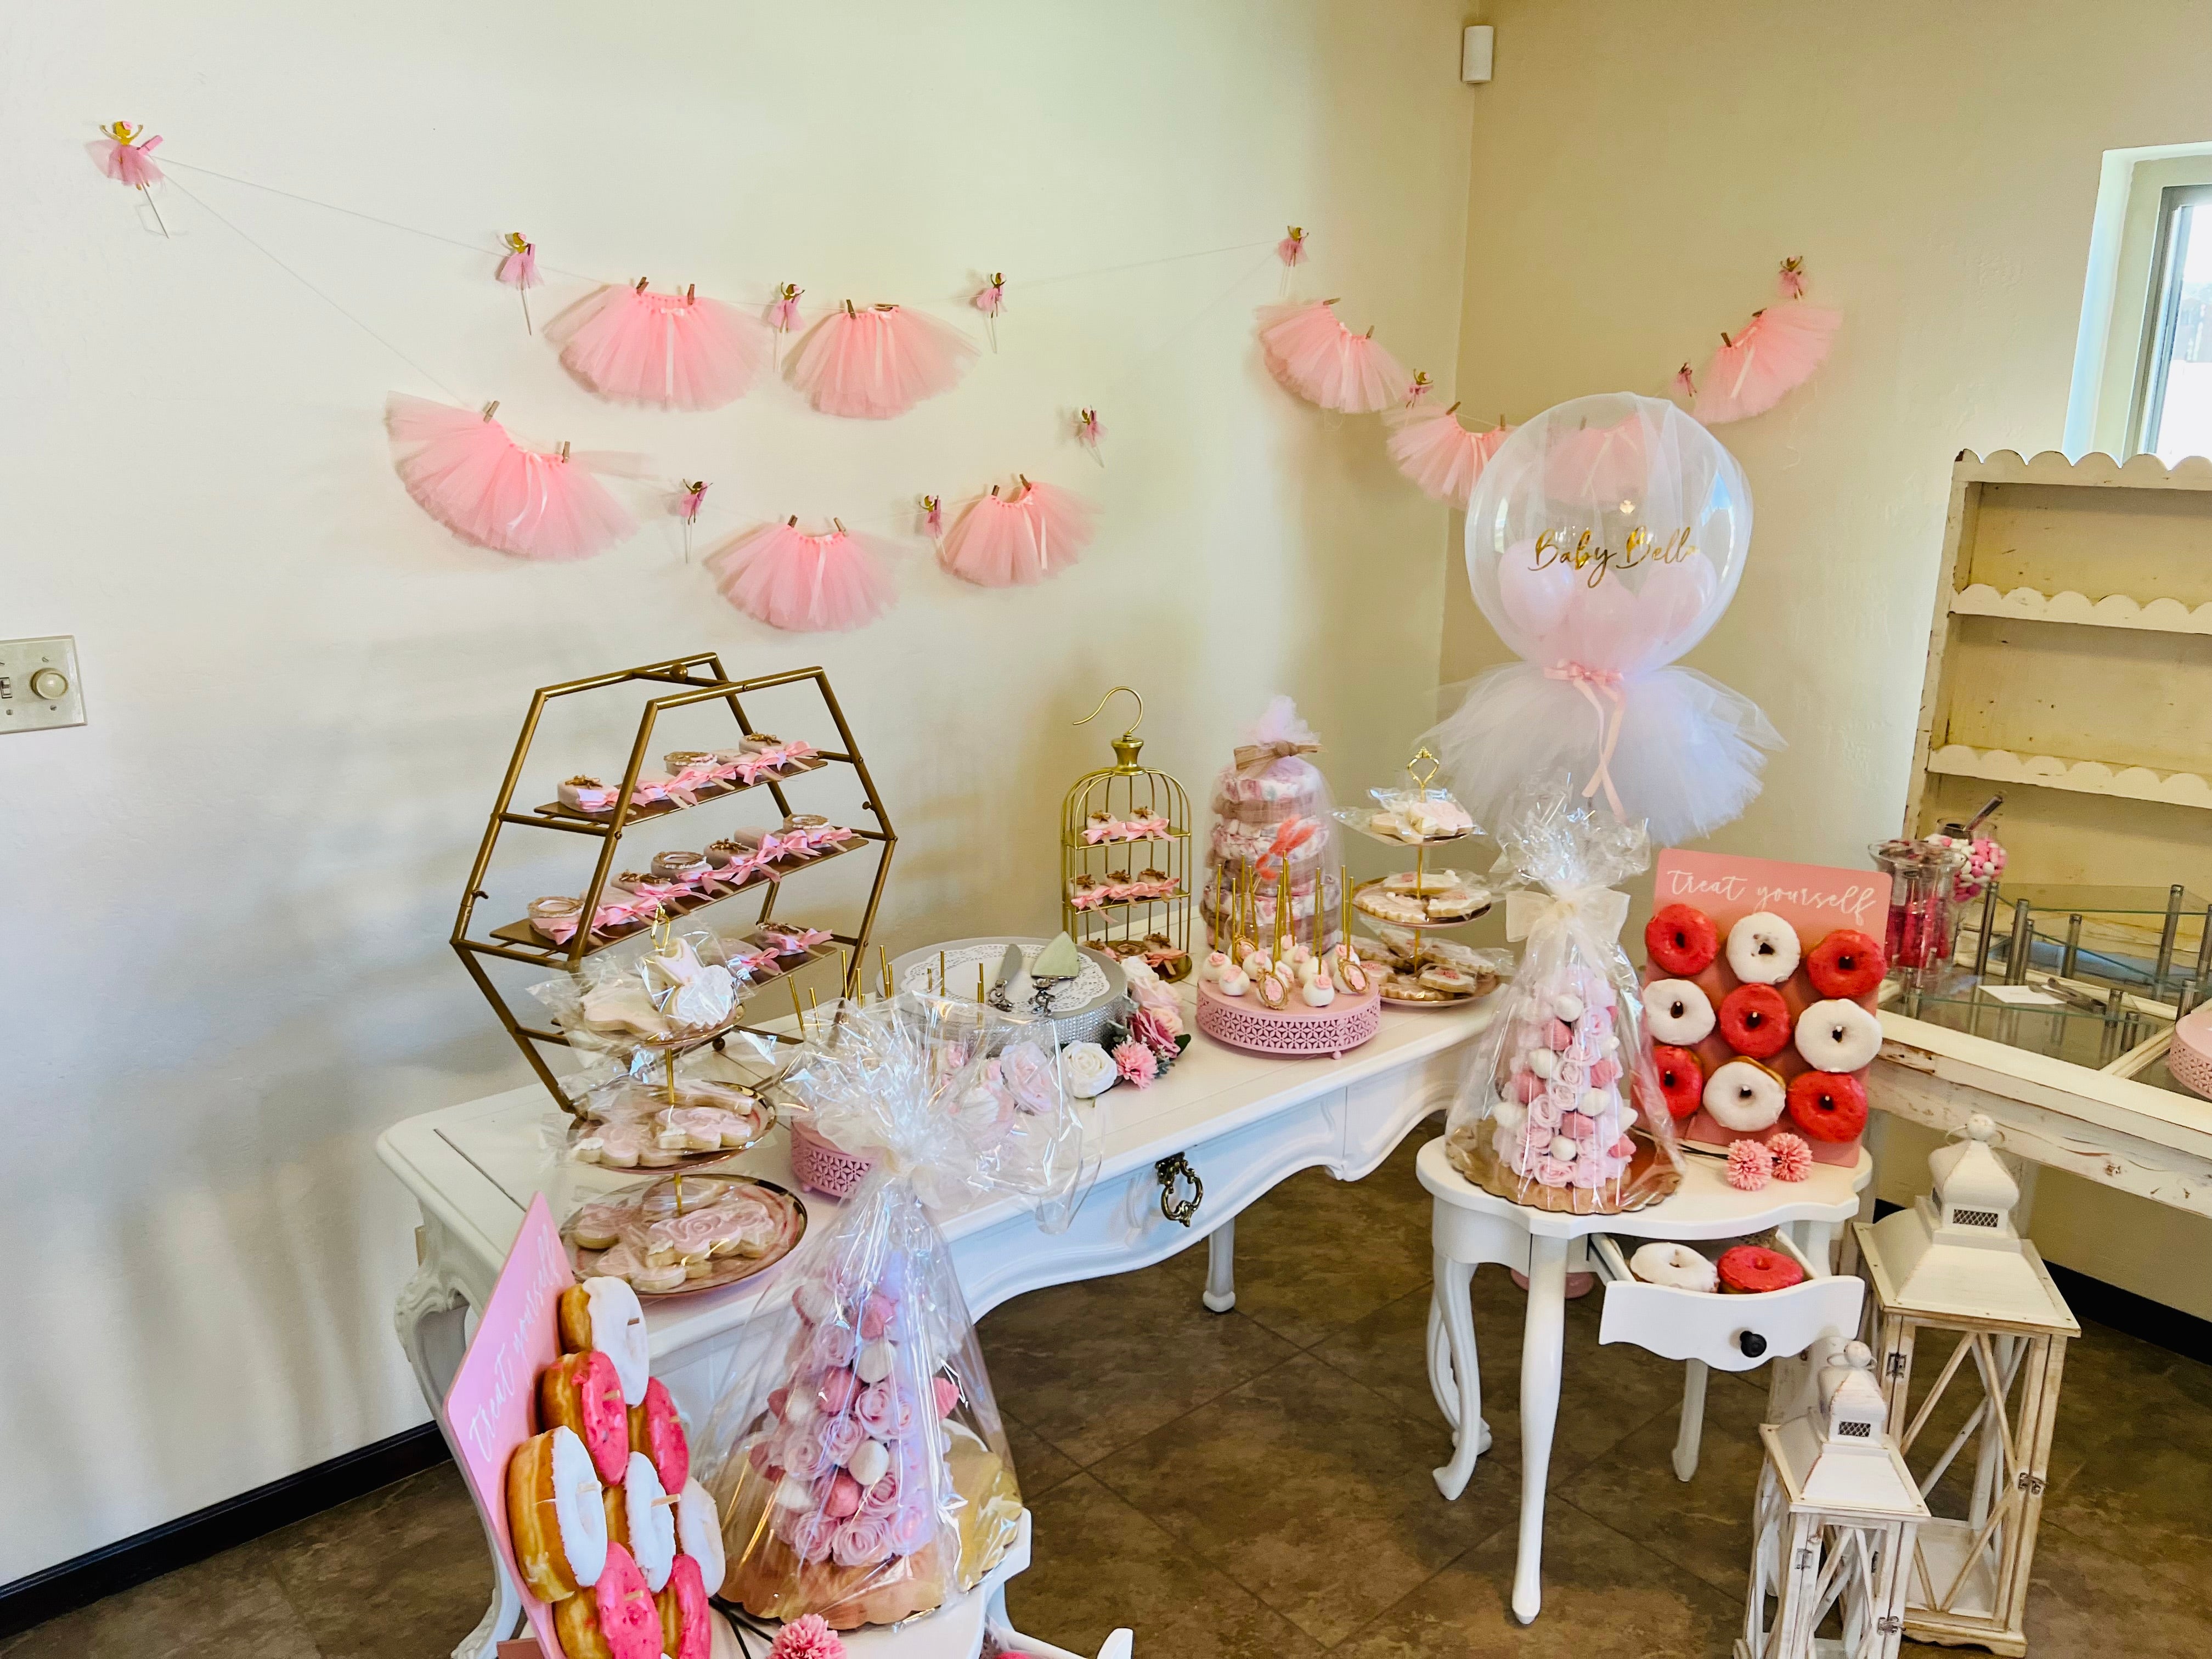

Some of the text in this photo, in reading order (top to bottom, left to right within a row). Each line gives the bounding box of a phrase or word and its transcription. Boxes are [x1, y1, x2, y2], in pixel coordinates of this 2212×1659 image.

[1527, 527, 1618, 589] Baby
[1755, 885, 1877, 927] yourself
[513, 1223, 563, 1391] yourself
